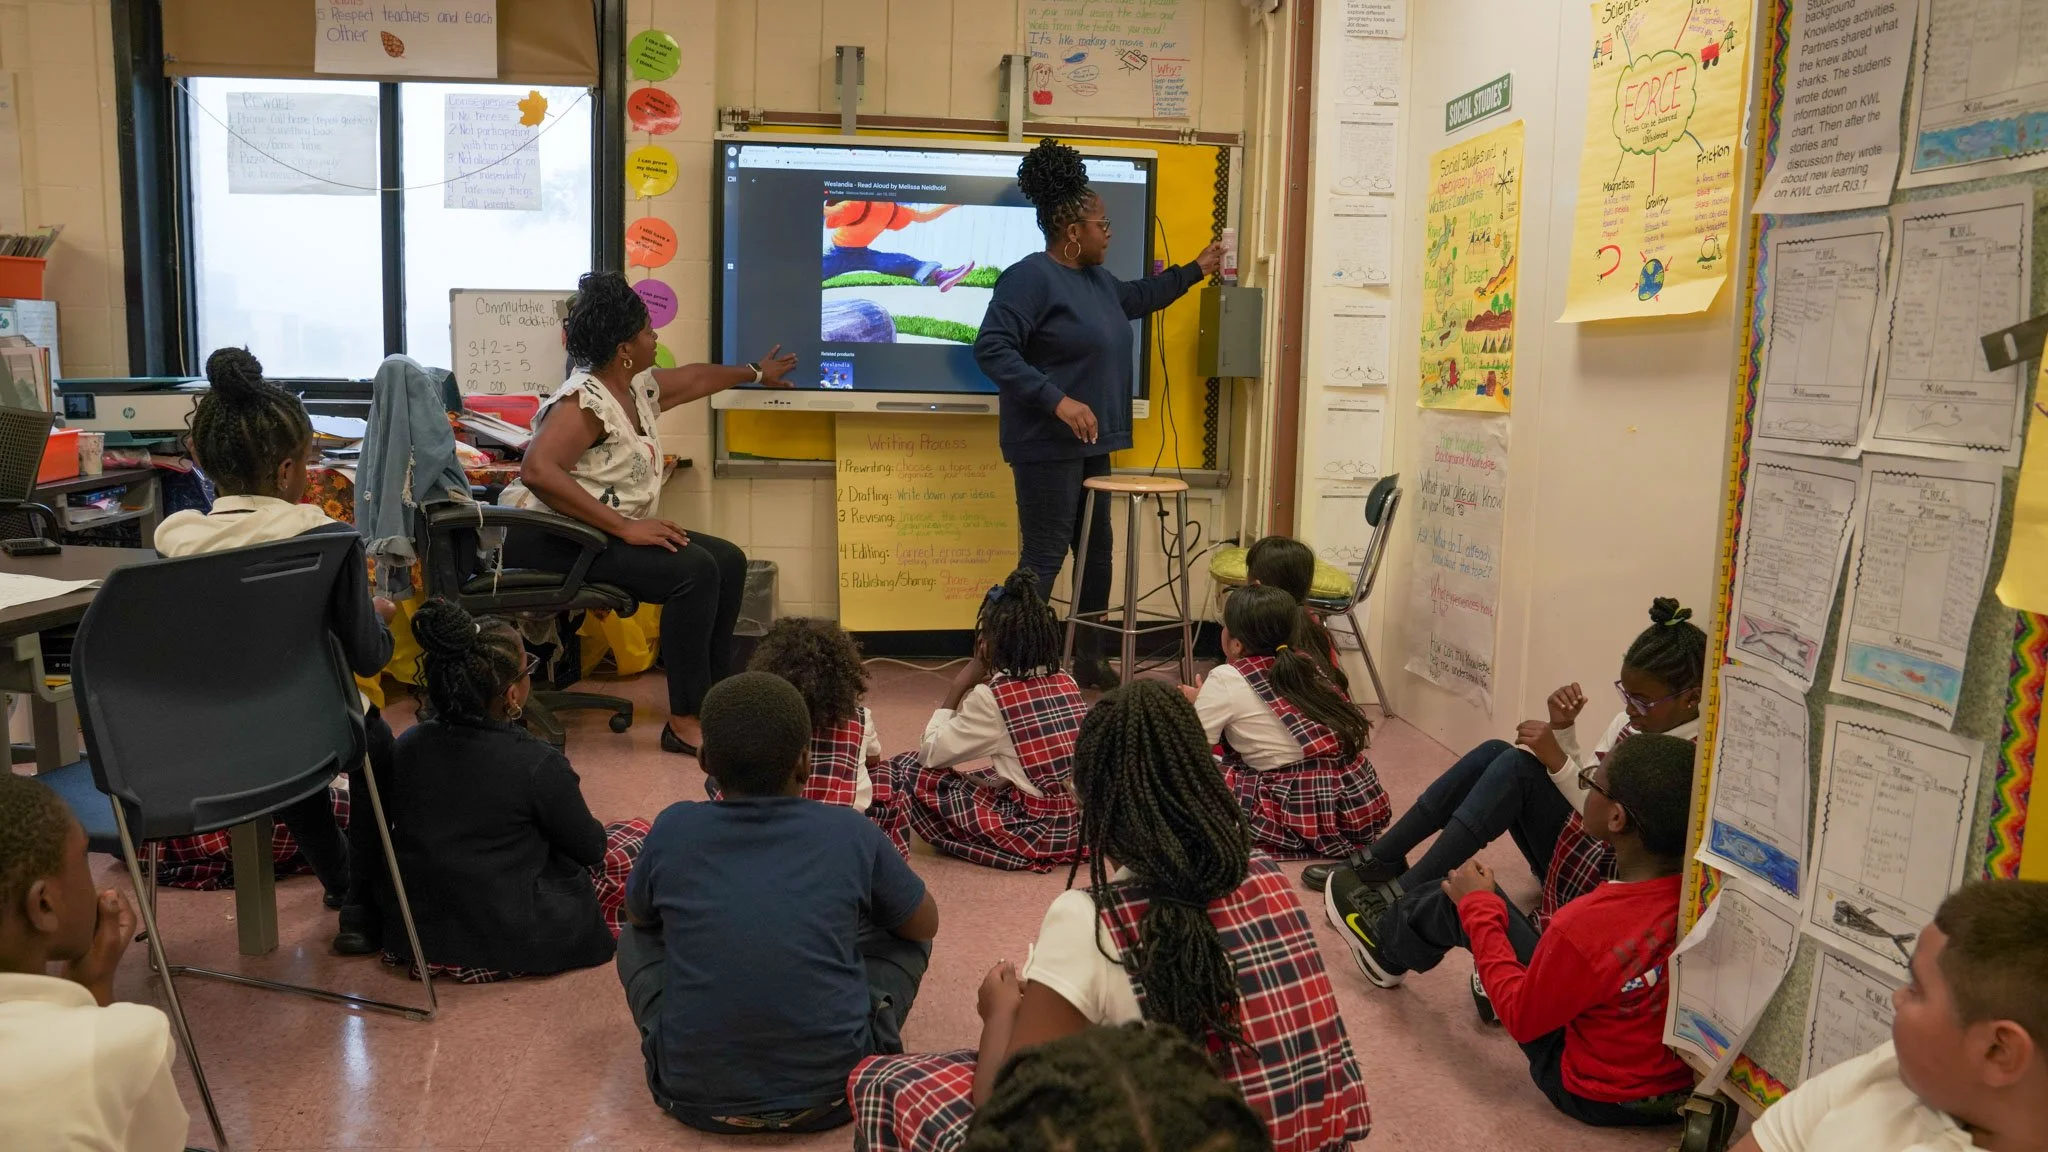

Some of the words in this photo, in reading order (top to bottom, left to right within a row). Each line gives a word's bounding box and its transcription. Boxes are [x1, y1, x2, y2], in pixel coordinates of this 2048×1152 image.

[316, 8, 326, 20] 5
[331, 6, 374, 24] Respect
[383, 4, 430, 23] teachers
[437, 11, 458, 23] and
[465, 11, 493, 24] each
[1803, 17, 1851, 40] Knowledge
[1853, 2, 1897, 24] activities.
[1805, 0, 1856, 23] background
[326, 24, 369, 42] Other
[1028, 31, 1052, 45] It's
[1058, 33, 1074, 46] like
[1078, 33, 1107, 50] making
[1119, 38, 1144, 48] movie
[1159, 41, 1177, 52] your
[1801, 38, 1839, 56] Partners
[1841, 24, 1872, 45] shared
[1875, 17, 1900, 35] what
[1799, 60, 1814, 72] the
[1816, 54, 1840, 68] knew
[1842, 43, 1868, 62] about
[1796, 73, 1829, 90] sharks.
[1833, 68, 1850, 81] The
[1852, 56, 1893, 76] students
[1448, 96, 1473, 127] SOCIAL
[1473, 81, 1503, 117] STUDIES
[1623, 66, 1688, 125] FORCE
[1794, 92, 1820, 105] wrote
[1821, 85, 1848, 100] down
[1793, 102, 1844, 122] information
[1845, 100, 1858, 111] on
[1860, 91, 1881, 108] KWL
[459, 122, 474, 135] Not
[1791, 124, 1815, 138] chart.
[1819, 119, 1843, 132] Then
[1844, 114, 1867, 128] after
[1867, 110, 1881, 123] the
[1789, 140, 1819, 154] stories
[1821, 134, 1839, 149] and
[1440, 153, 1460, 178] Social
[1696, 144, 1731, 170] Friction
[1786, 154, 1833, 170] discussion
[1835, 150, 1857, 163] they
[1858, 145, 1883, 159] wrote
[1780, 171, 1808, 184] about
[1809, 170, 1828, 181] new
[1830, 162, 1869, 177] learning
[890, 182, 897, 191] by
[921, 183, 947, 191] Neidhold
[1602, 178, 1635, 197] Magnetism
[1774, 189, 1788, 198] on
[1789, 185, 1812, 198] KWL
[1645, 195, 1669, 213] Gravity
[1464, 264, 1489, 284] Desert
[475, 297, 545, 316] Commutative
[867, 433, 915, 457] Writing
[919, 432, 967, 450] Process
[844, 459, 894, 476] Prewriting:
[895, 459, 932, 472] Choose
[949, 462, 973, 475] topic
[979, 461, 997, 471] and
[1420, 467, 1438, 496] What
[848, 485, 892, 506] Drafting:
[896, 487, 920, 499] Write
[923, 487, 945, 499] down
[950, 491, 966, 502] your
[838, 509, 846, 523] 3
[851, 507, 895, 527] Revising:
[839, 545, 848, 560] 4
[851, 544, 890, 565] Editing:
[895, 542, 934, 558] Correct
[840, 572, 850, 588] 5
